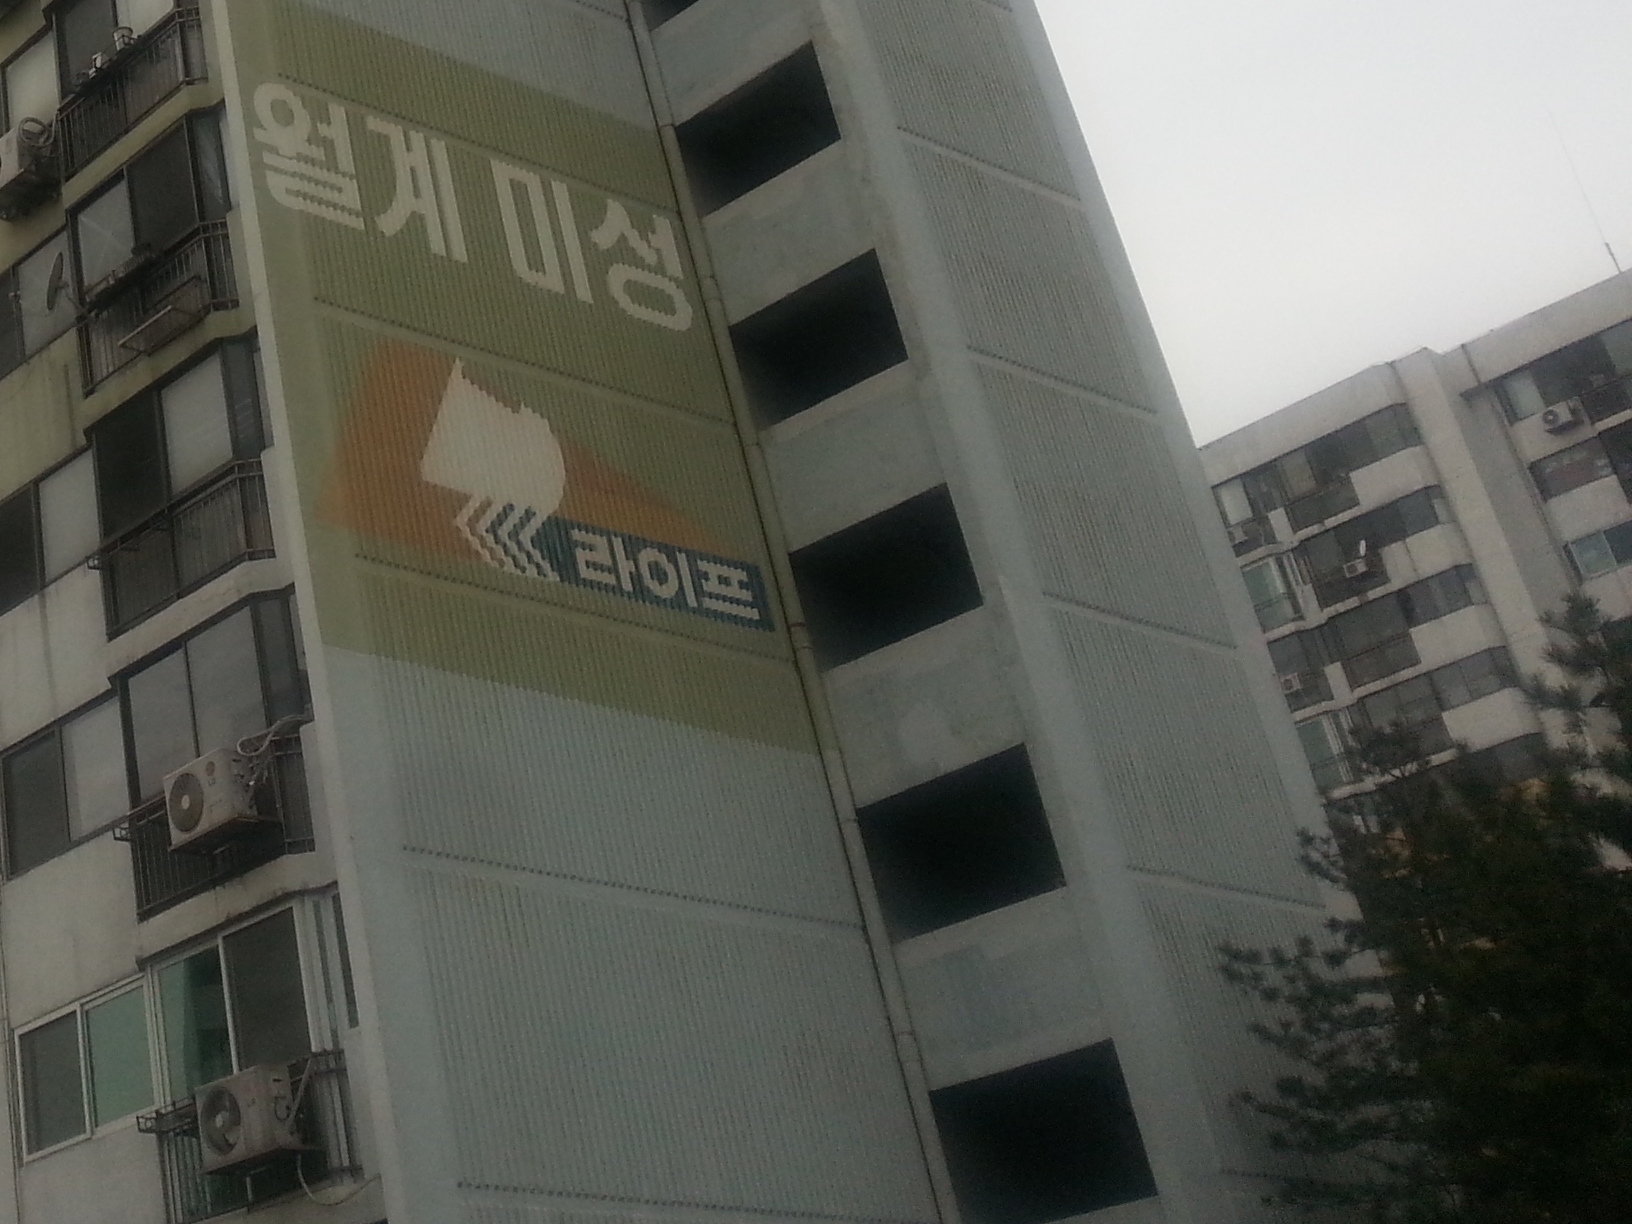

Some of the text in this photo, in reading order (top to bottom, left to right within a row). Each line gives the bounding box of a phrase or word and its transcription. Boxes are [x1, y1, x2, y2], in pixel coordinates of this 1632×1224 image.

[253, 81, 693, 332] 월계 미성
[569, 527, 762, 621] 라이프
